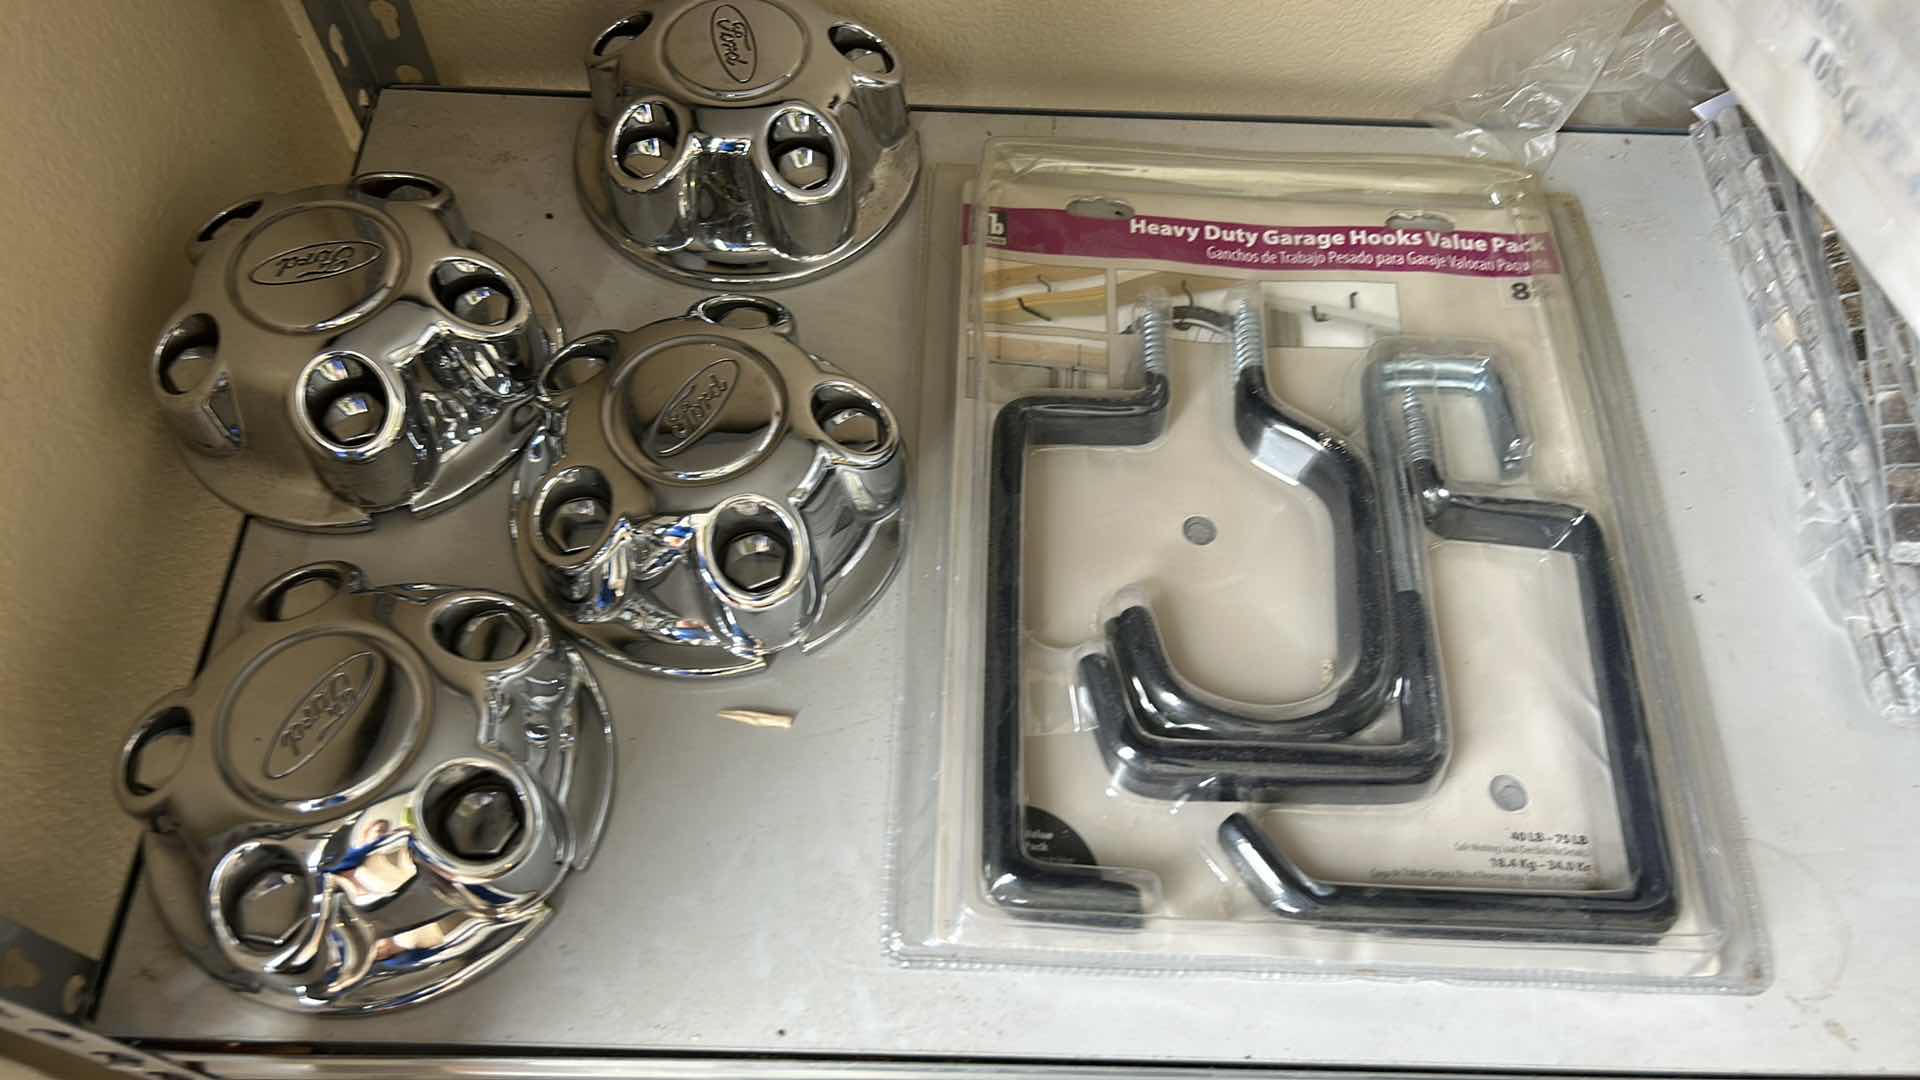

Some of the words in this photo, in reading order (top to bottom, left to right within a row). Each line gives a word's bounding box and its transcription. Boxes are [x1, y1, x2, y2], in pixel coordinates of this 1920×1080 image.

[715, 17, 753, 67] Ford
[1129, 218, 1200, 242] Heavy
[1204, 225, 1259, 247] Duty
[1262, 229, 1345, 249] Garage
[1349, 228, 1423, 246] Hooks
[1424, 231, 1488, 251] Value
[1491, 236, 1544, 253] Pack
[274, 245, 355, 279] Ford
[1206, 245, 1259, 263] Ganchos
[1260, 250, 1278, 264] de
[1279, 251, 1326, 266] Trabajo
[1327, 251, 1374, 265] Pesado
[1375, 254, 1405, 267] para
[1406, 251, 1446, 269] Garaje
[1511, 282, 1530, 300] 8
[662, 372, 728, 440] Ford
[279, 671, 357, 757] Ford
